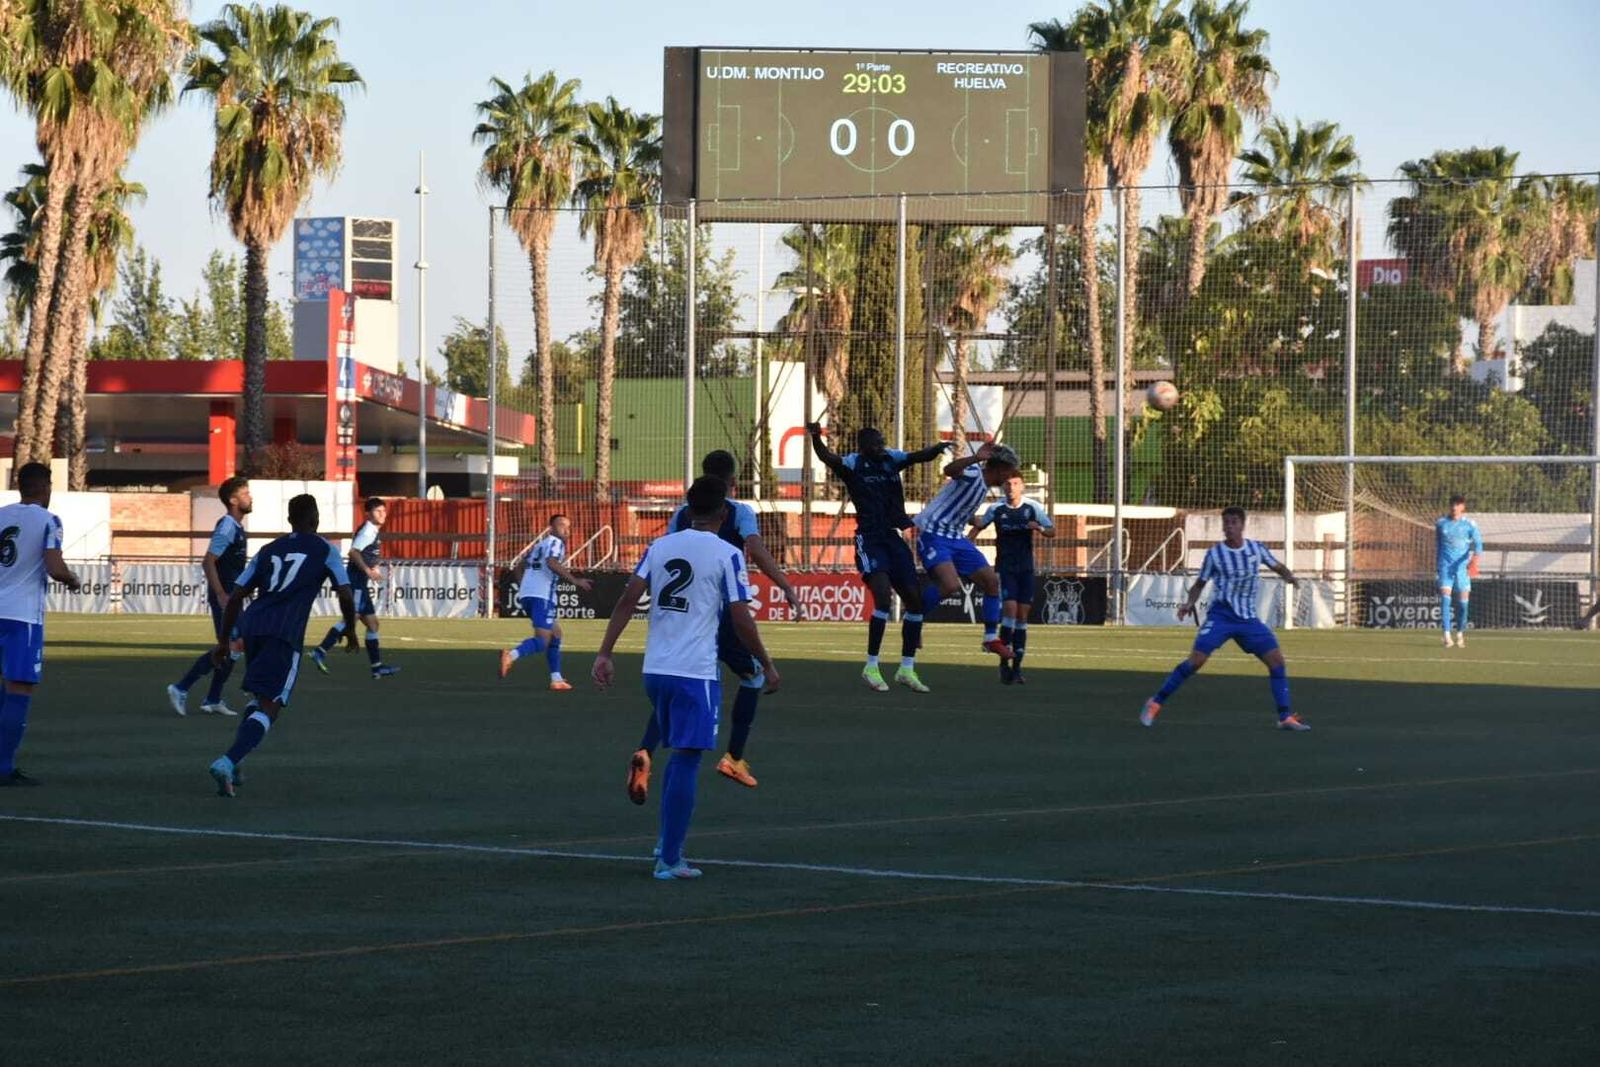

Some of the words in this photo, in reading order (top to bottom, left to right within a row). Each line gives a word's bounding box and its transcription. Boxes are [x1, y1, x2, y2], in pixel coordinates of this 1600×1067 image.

[706, 66, 751, 80] U.DM.
[754, 67, 825, 80] MONTIJO
[866, 63, 891, 72] Parte
[936, 62, 1024, 75] RECREATIVO
[842, 73, 906, 94] 29:03
[954, 77, 1008, 89] HUELVA
[830, 118, 857, 156] 0
[888, 119, 915, 157] 0
[0, 525, 21, 568] 6
[267, 552, 307, 592] 17
[122, 578, 199, 600] pinmader
[394, 583, 476, 602] pinmader
[657, 558, 695, 613] 2
[769, 607, 784, 621] DE
